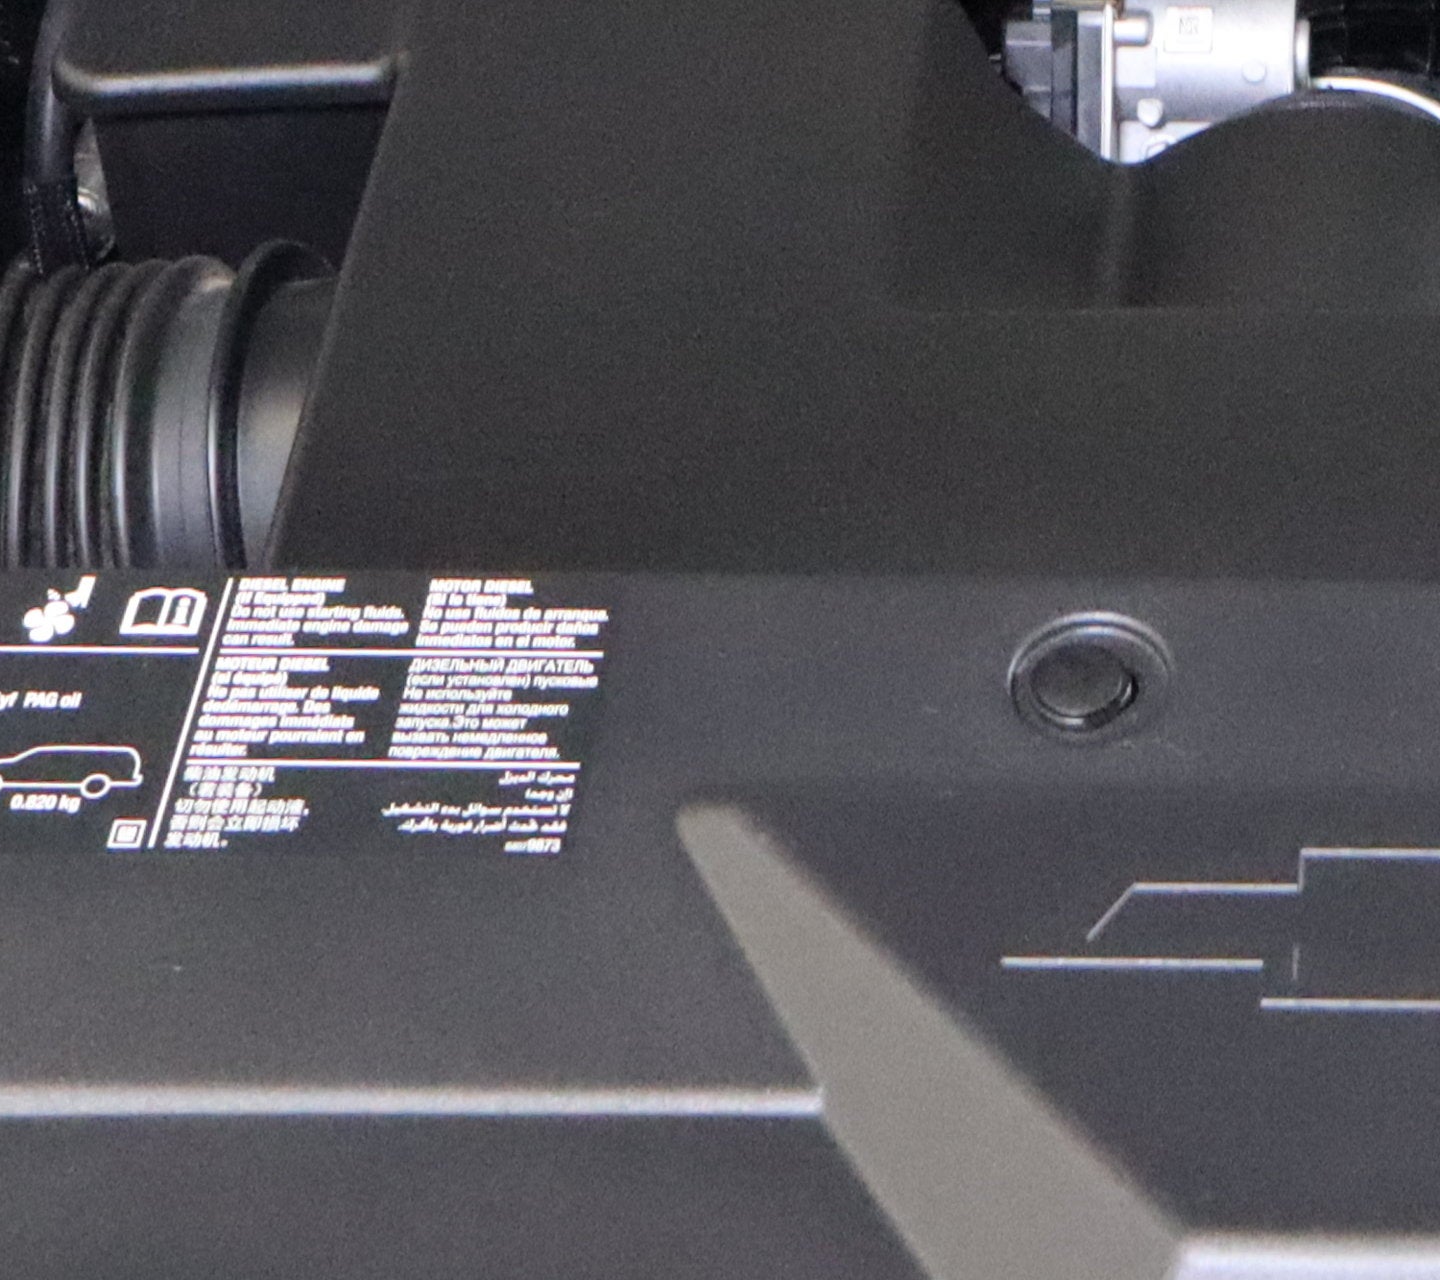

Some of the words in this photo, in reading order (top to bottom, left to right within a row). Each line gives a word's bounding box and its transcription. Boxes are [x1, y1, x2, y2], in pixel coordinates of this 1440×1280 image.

[238, 577, 289, 592] DIESEL
[291, 577, 347, 593] ENGINE
[429, 578, 482, 593] MOTOR
[483, 578, 534, 594] DIESEL
[253, 592, 326, 607] Equipped)
[448, 593, 464, 607] lo
[465, 593, 507, 608] tiene)
[230, 605, 252, 619] Do
[252, 605, 278, 619] not
[278, 606, 306, 619] use
[306, 605, 361, 621] starting
[363, 605, 405, 619] fluids.
[422, 606, 444, 620] No
[445, 607, 471, 620] use
[473, 607, 521, 621] fluidos
[523, 606, 542, 621] de
[543, 608, 609, 623] arranque.
[226, 618, 301, 633] Immediate
[302, 620, 351, 635] engine
[352, 620, 409, 636] damage
[419, 620, 439, 634] Se
[440, 621, 493, 636] pueden
[494, 621, 555, 636] producir
[555, 621, 599, 636] daños
[222, 633, 250, 646] can
[251, 633, 295, 646] result.
[493, 635, 514, 648] en
[515, 634, 531, 648] el
[532, 635, 575, 649] motor.
[215, 656, 278, 671] MOTEUR
[278, 657, 330, 672] DIESEL
[408, 656, 505, 673] ДИЗЕЛЬНЫЙ
[505, 658, 595, 675] ДВИГАТЕЛЬ
[211, 671, 232, 686] (si
[406, 673, 445, 688] (если
[446, 674, 531, 690] установлен)
[533, 675, 599, 690] пусковые
[23, 691, 57, 709] PAG
[59, 691, 83, 710] oil
[207, 685, 228, 699] Ne
[228, 686, 256, 700] pas
[258, 685, 309, 700] utiliser
[310, 685, 330, 700] de
[331, 685, 380, 702] liquide
[403, 687, 424, 700] Не
[424, 687, 513, 704] используйте
[302, 700, 331, 714] Des
[398, 702, 465, 716] жидкости
[465, 704, 495, 716] для
[495, 704, 570, 717] холодного
[198, 714, 278, 730] dommages
[279, 714, 355, 729] immédiats
[481, 717, 529, 730] может
[194, 729, 214, 742] au
[215, 728, 269, 742] moteur
[268, 729, 344, 745] pourraient
[345, 730, 365, 744] en
[391, 730, 450, 744] вызвать
[189, 742, 248, 757] résulter.
[387, 745, 484, 760] повреждение
[10, 793, 57, 811] 0.820
[57, 795, 81, 814] kg
